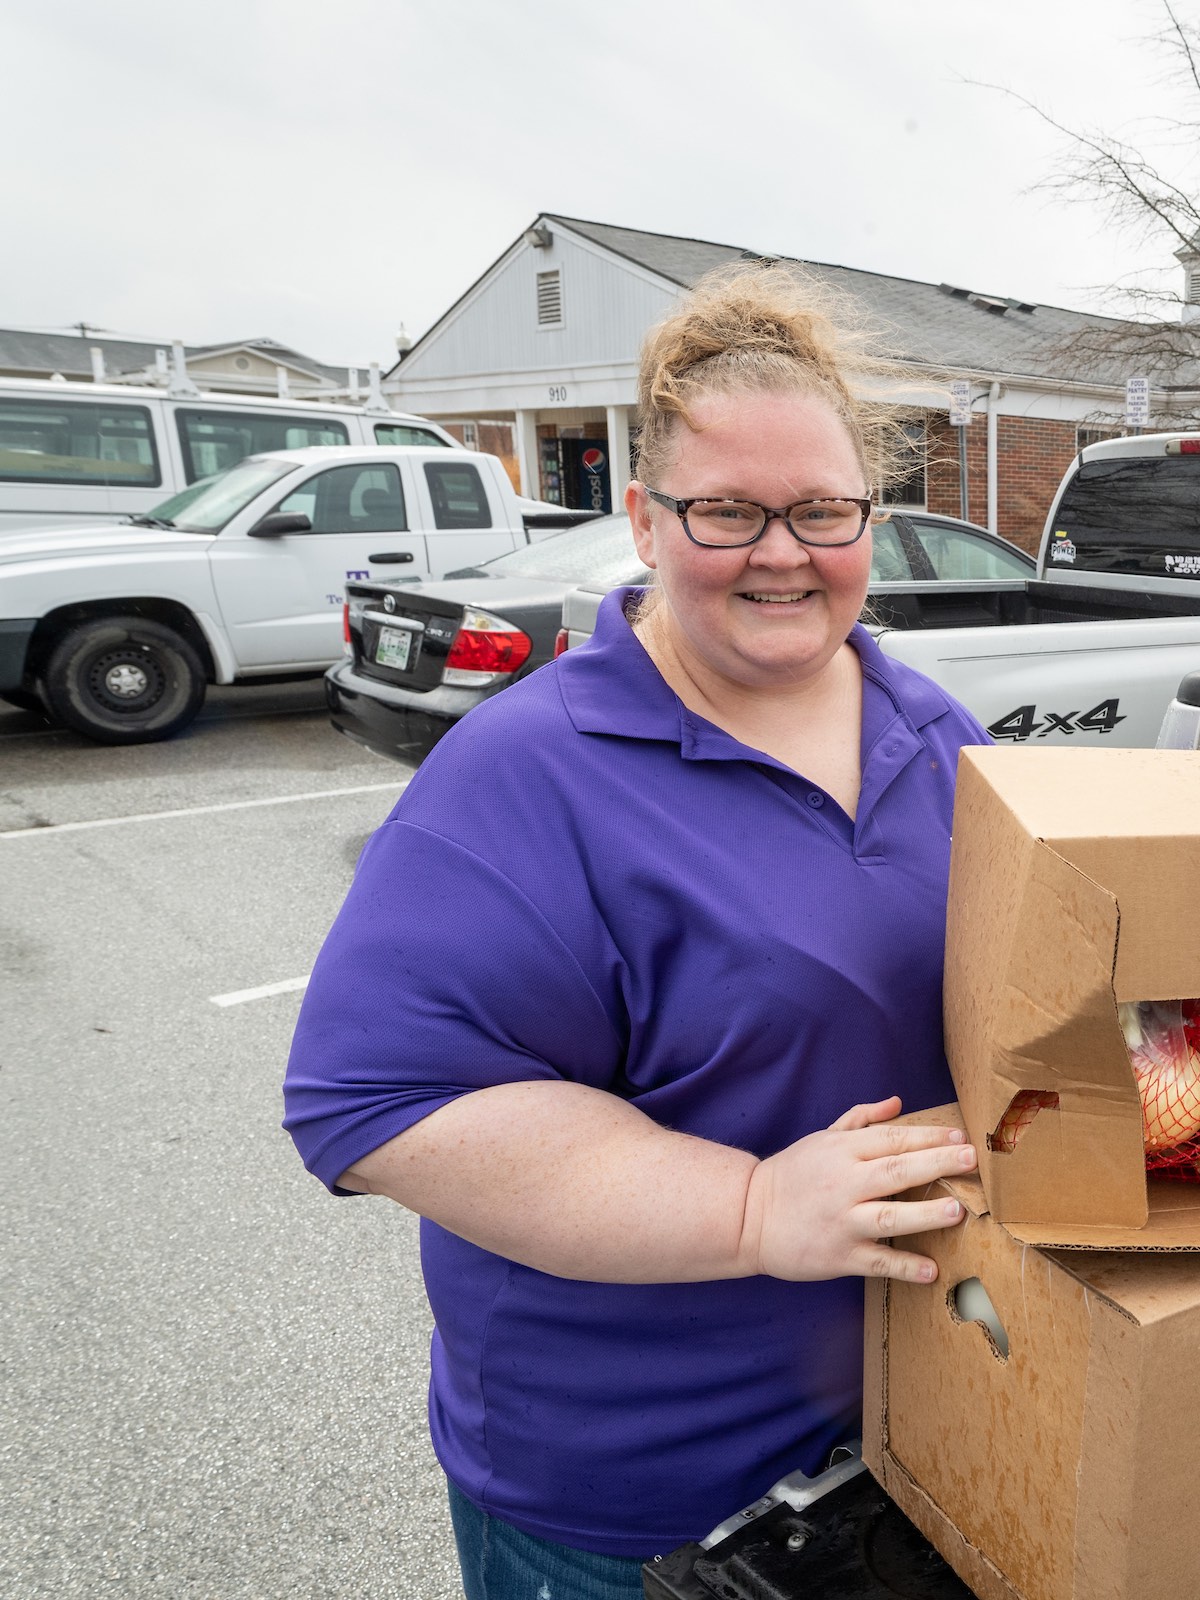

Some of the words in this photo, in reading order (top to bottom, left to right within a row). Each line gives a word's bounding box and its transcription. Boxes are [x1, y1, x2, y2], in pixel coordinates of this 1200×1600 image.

[549, 386, 567, 401] 910
[588, 475, 604, 511] epsi
[1052, 545, 1075, 557] POWER
[986, 698, 1127, 742] 4x4
